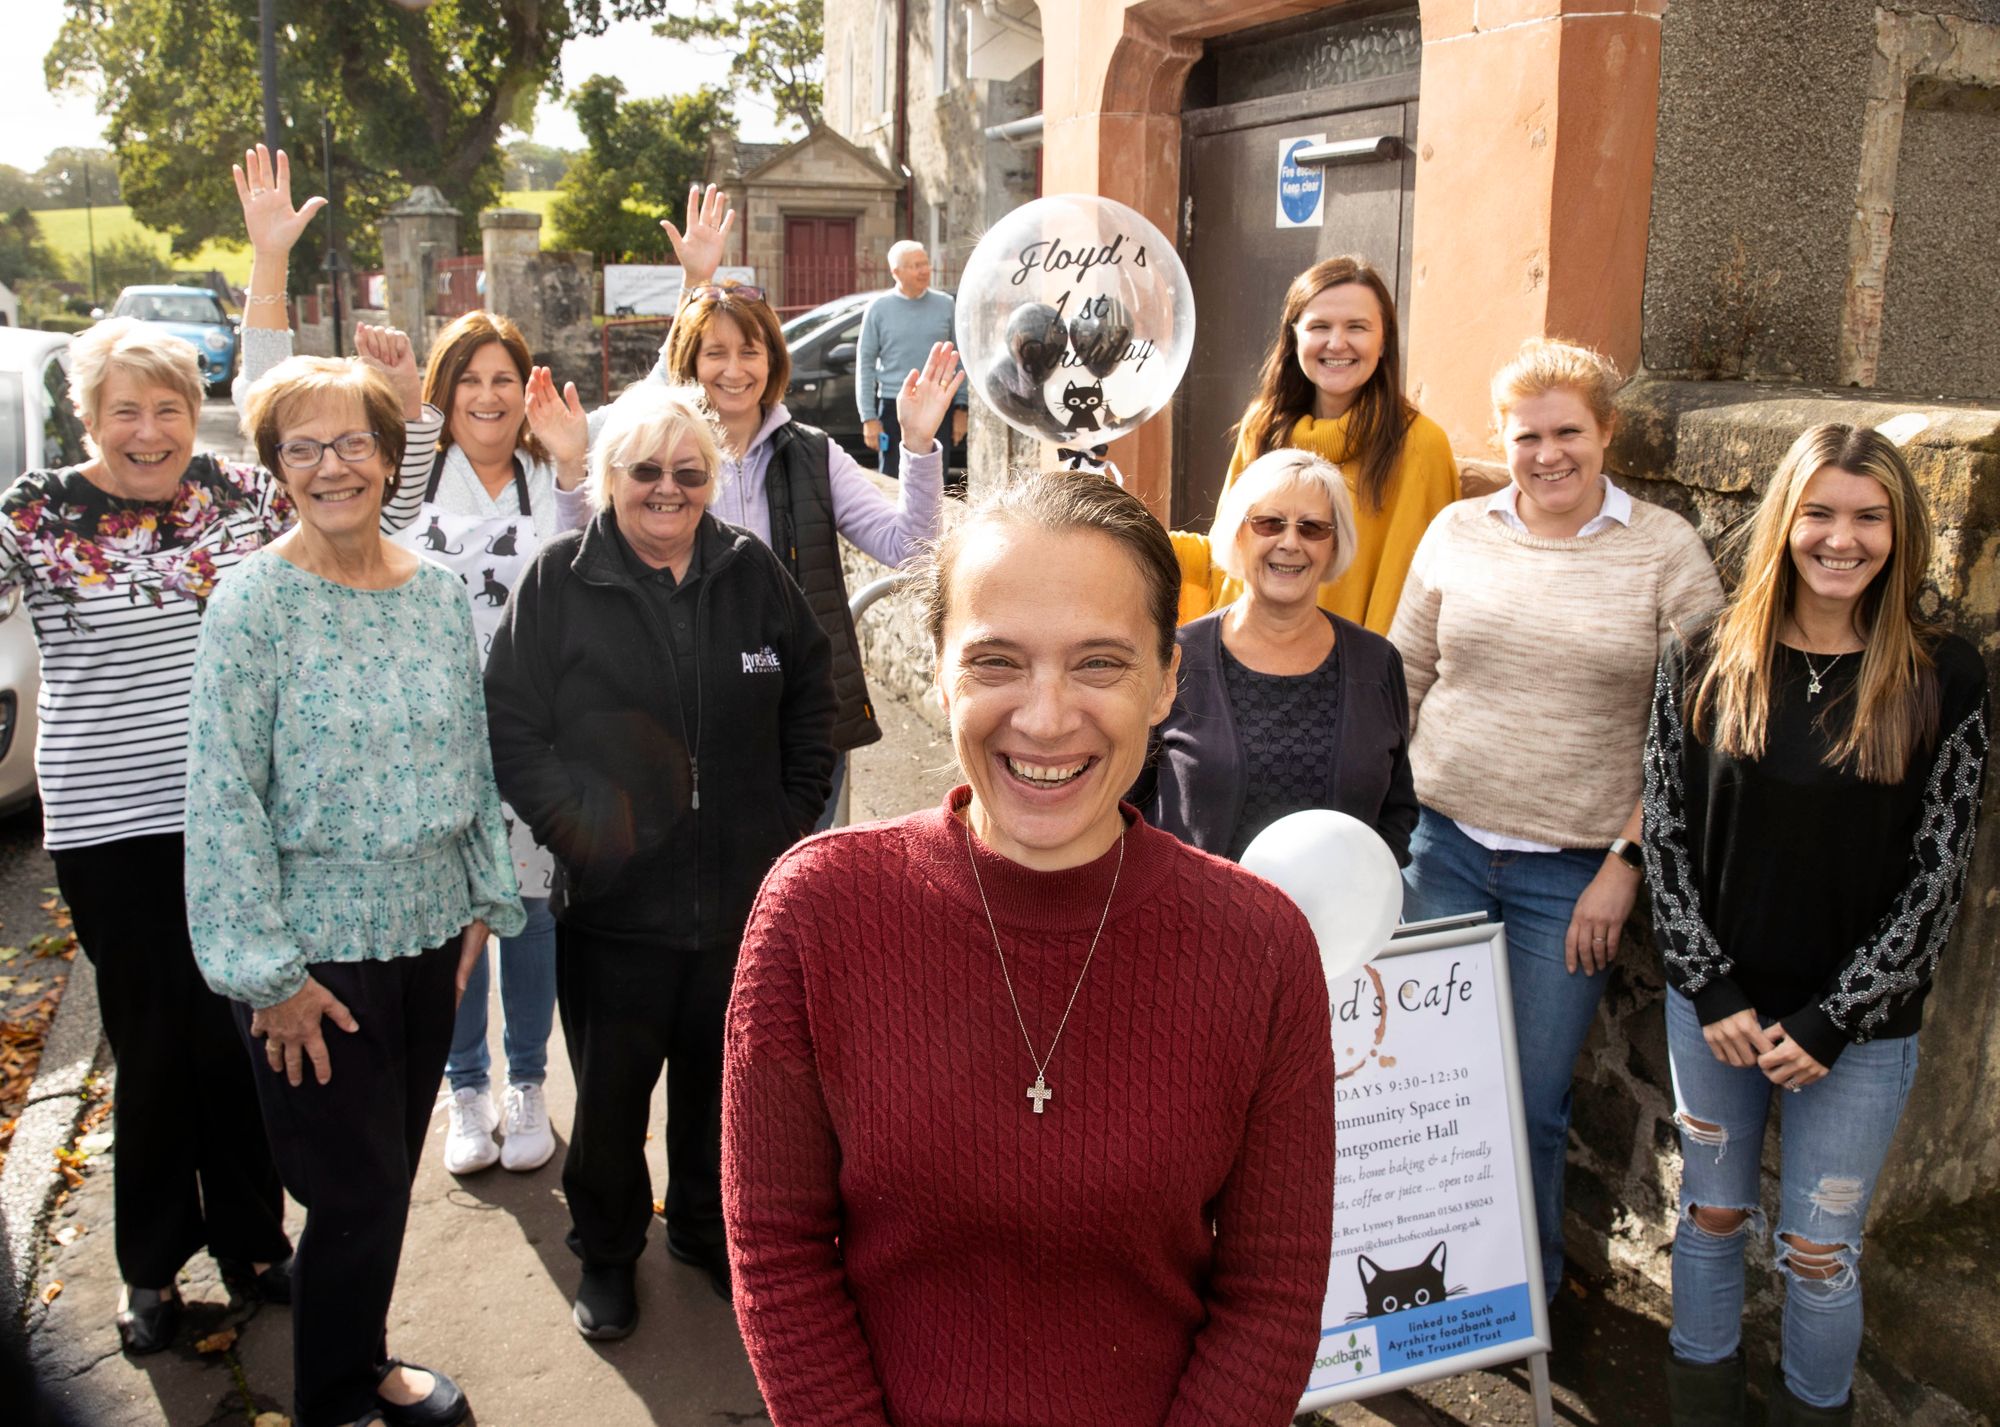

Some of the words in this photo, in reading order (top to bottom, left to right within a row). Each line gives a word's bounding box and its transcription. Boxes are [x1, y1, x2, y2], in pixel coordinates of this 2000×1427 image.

[1283, 182, 1300, 194] Keep
[1302, 180, 1320, 192] clear
[1011, 234, 1147, 286] Floyd's
[1331, 978, 1383, 1022] d's
[1398, 961, 1473, 1016] Cafe
[1336, 1082, 1384, 1103] DAYS
[1388, 1067, 1470, 1094] 9:30-12:30
[1335, 1106, 1406, 1131] mmunity
[1409, 1096, 1452, 1120] Space
[1455, 1092, 1472, 1108] in
[1335, 1129, 1422, 1160] ontgomerie
[1426, 1119, 1460, 1142] Hall
[1358, 1165, 1387, 1181] home
[1388, 1156, 1426, 1176] baking
[1427, 1153, 1439, 1167] &
[1441, 1153, 1448, 1164] a
[1449, 1140, 1493, 1167] friendly
[1333, 1199, 1349, 1212] ea,
[1350, 1187, 1382, 1209] coffee
[1384, 1189, 1396, 1201] or
[1397, 1183, 1423, 1201] juice
[1438, 1176, 1462, 1193] open
[1463, 1172, 1475, 1184] to
[1476, 1164, 1495, 1182] all.
[1332, 1216, 1482, 1259] rennan@churchofscotland.org.uk
[1342, 1226, 1361, 1238] Rev
[1362, 1218, 1396, 1234] Lynsey
[1397, 1209, 1437, 1226] Brennan
[1437, 1202, 1464, 1217] 01563
[1388, 1333, 1437, 1352] Ayrshire
[1439, 1318, 1493, 1339] foodbank
[1495, 1311, 1517, 1326] and
[1408, 1315, 1444, 1334] linked
[1446, 1314, 1459, 1326] to
[1461, 1304, 1494, 1321] South
[1315, 1344, 1373, 1370] oodbank
[1406, 1348, 1425, 1361] the
[1427, 1334, 1471, 1356] Trussell
[1473, 1328, 1503, 1344] Trust
